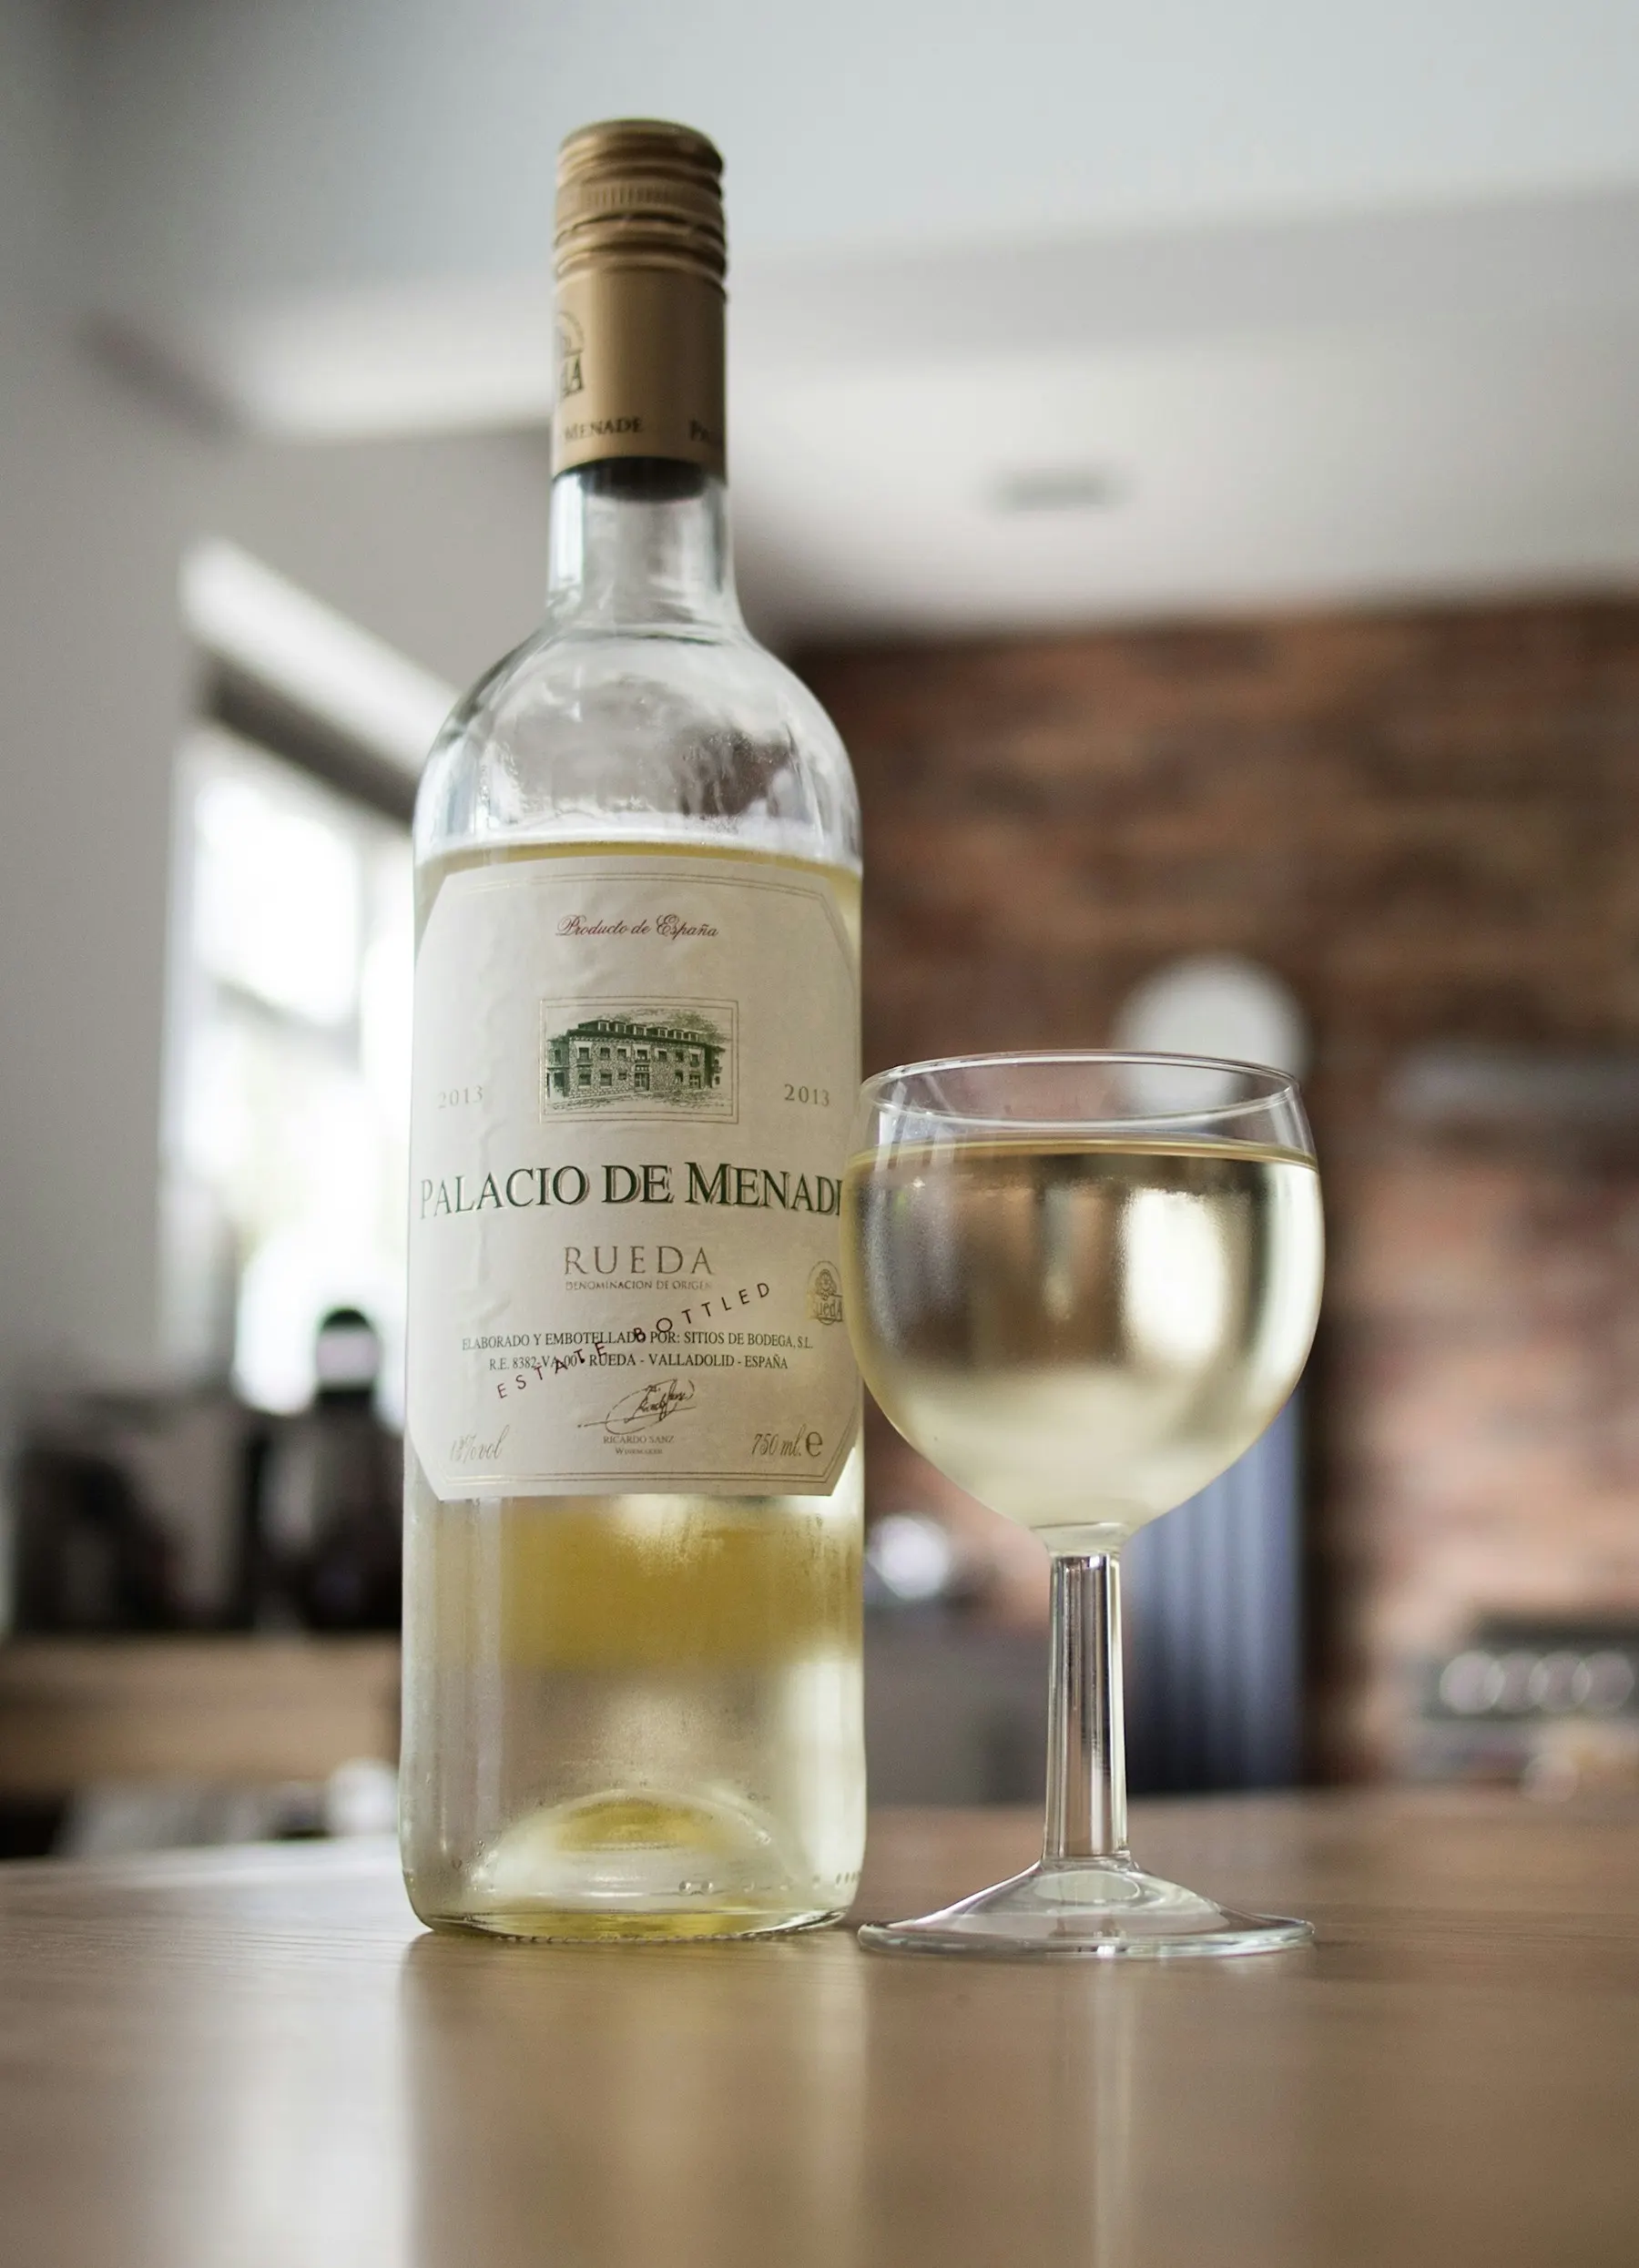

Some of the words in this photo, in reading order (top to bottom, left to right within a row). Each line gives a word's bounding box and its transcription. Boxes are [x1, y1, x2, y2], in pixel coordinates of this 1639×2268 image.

[565, 417, 643, 441] MENADE
[555, 914, 629, 936] Producto
[630, 919, 652, 935] de
[656, 913, 719, 941] España
[438, 1085, 484, 1109] 2013
[784, 1083, 830, 1107] 2013
[420, 1165, 590, 1220] PALACIO
[601, 1164, 675, 1205] DE
[564, 1245, 714, 1275] RUEDA
[656, 1279, 671, 1290] DE
[462, 1333, 530, 1351] ELABORADO
[534, 1333, 543, 1346] Y
[650, 1331, 680, 1344] POR:
[684, 1331, 725, 1345] SITIOS
[728, 1332, 745, 1345] DE
[748, 1333, 796, 1348] BODEGA,
[496, 1341, 608, 1398] ESTATE
[634, 1282, 769, 1343] BOTTLED
[489, 1358, 510, 1370] R.E.
[589, 1352, 636, 1367] RUEDA
[648, 1353, 735, 1367] VALLADOLID
[745, 1354, 789, 1369] ESPAÑA
[603, 1436, 646, 1444] RICARDO
[751, 1433, 779, 1456] 750
